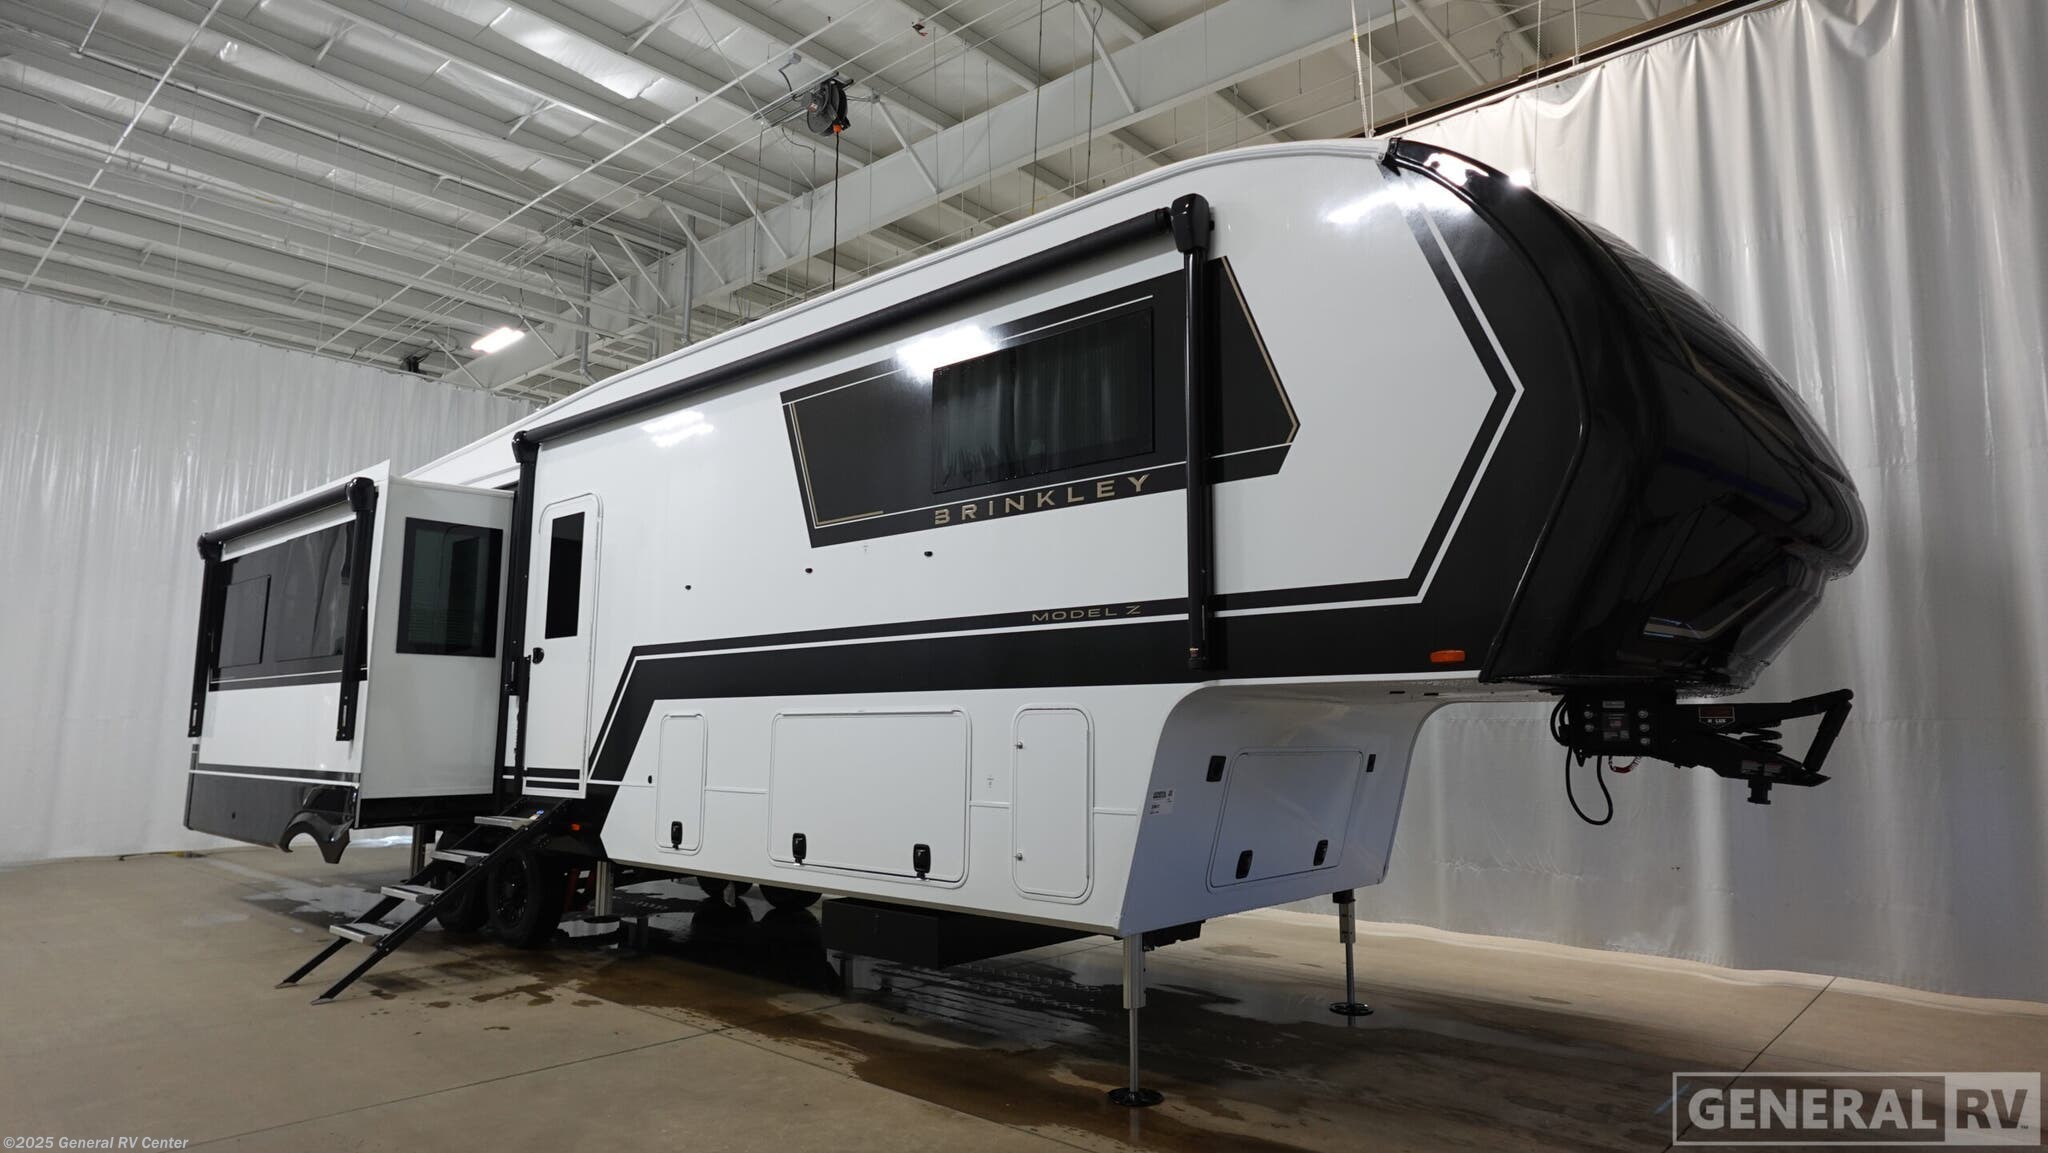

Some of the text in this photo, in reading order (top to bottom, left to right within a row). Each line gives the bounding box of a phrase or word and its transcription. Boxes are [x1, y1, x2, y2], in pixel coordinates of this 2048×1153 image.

[934, 474, 1150, 525] BRINKLEY
[1031, 605, 1141, 622] MODEL Z
